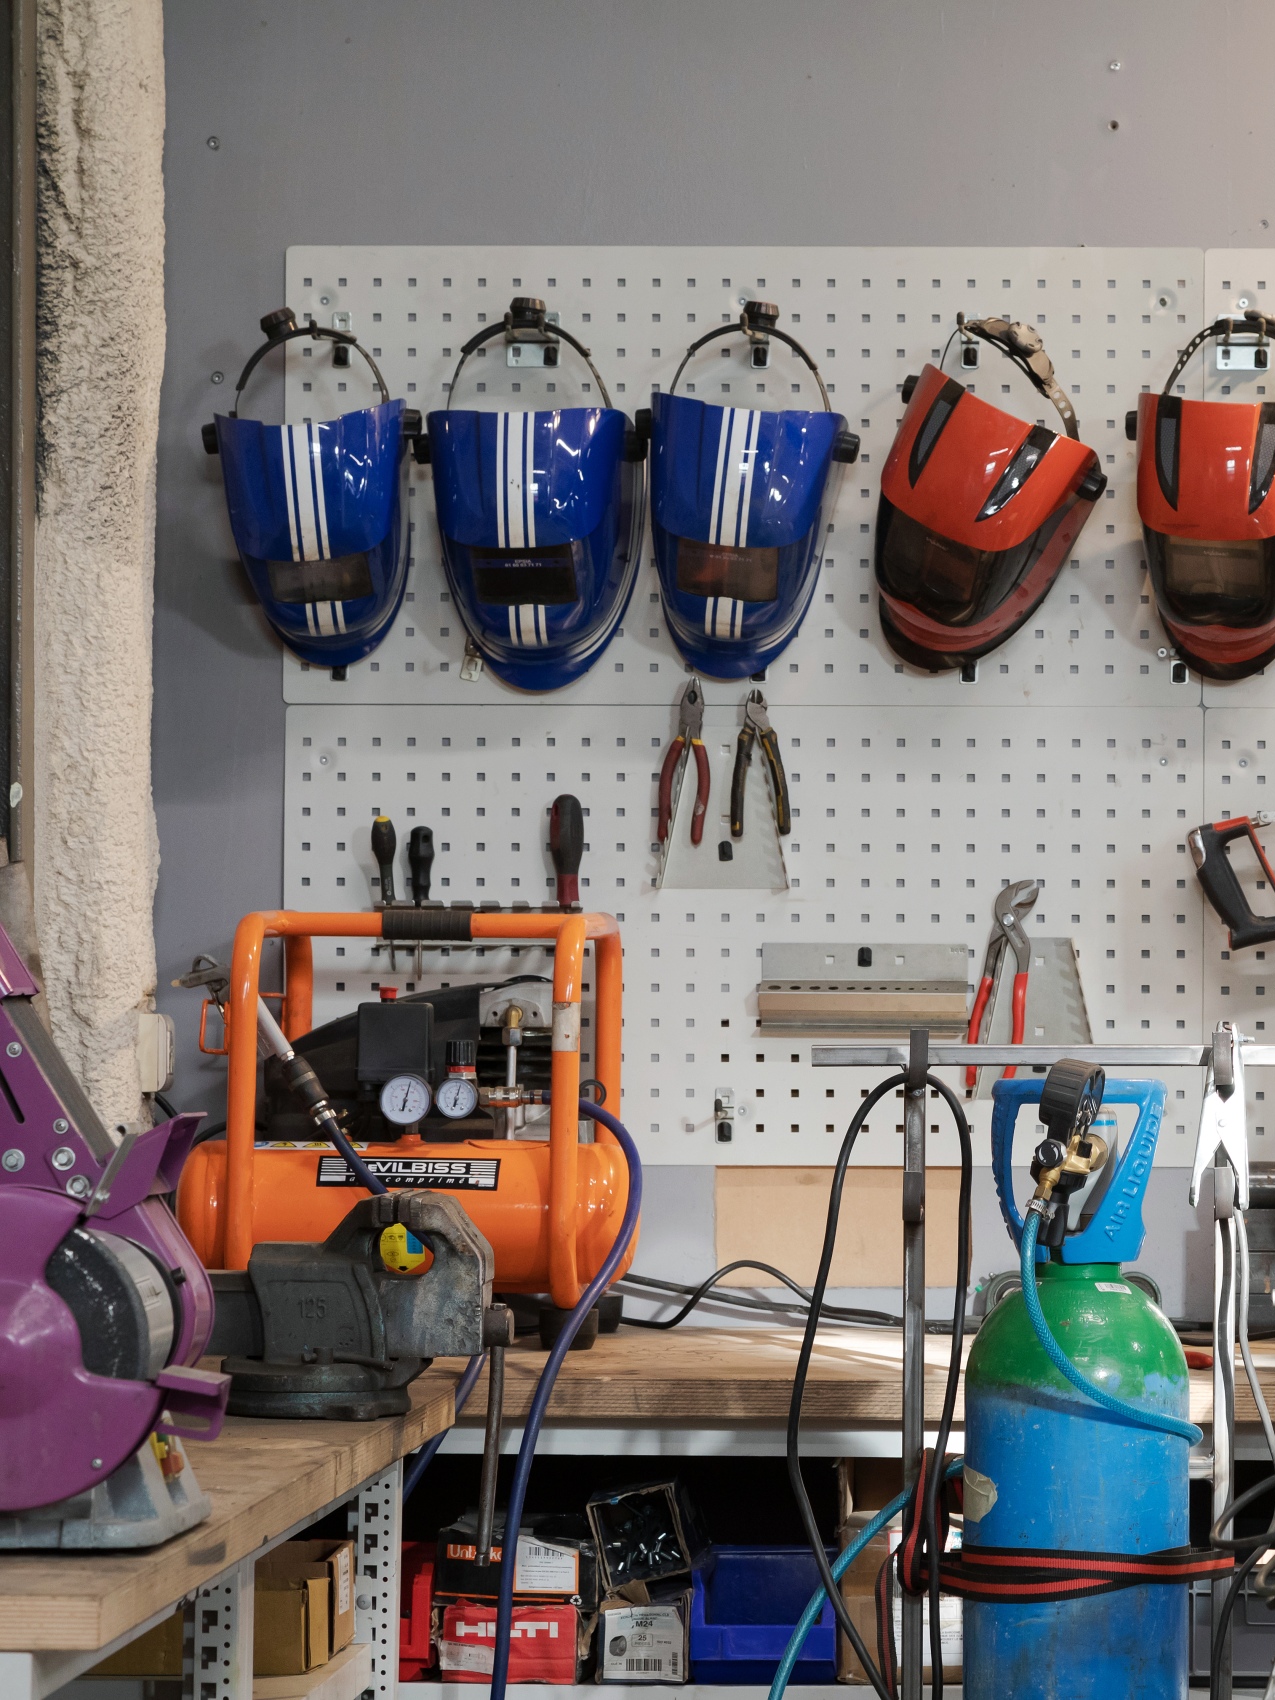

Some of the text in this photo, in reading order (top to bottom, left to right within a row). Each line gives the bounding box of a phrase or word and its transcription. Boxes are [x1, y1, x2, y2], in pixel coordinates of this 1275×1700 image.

[1104, 1102, 1162, 1242] AIR LIQUIDE
[385, 1176, 465, 1184] comprimé
[299, 1298, 326, 1319] 125
[635, 1620, 654, 1628] M24
[637, 1634, 647, 1642] 25
